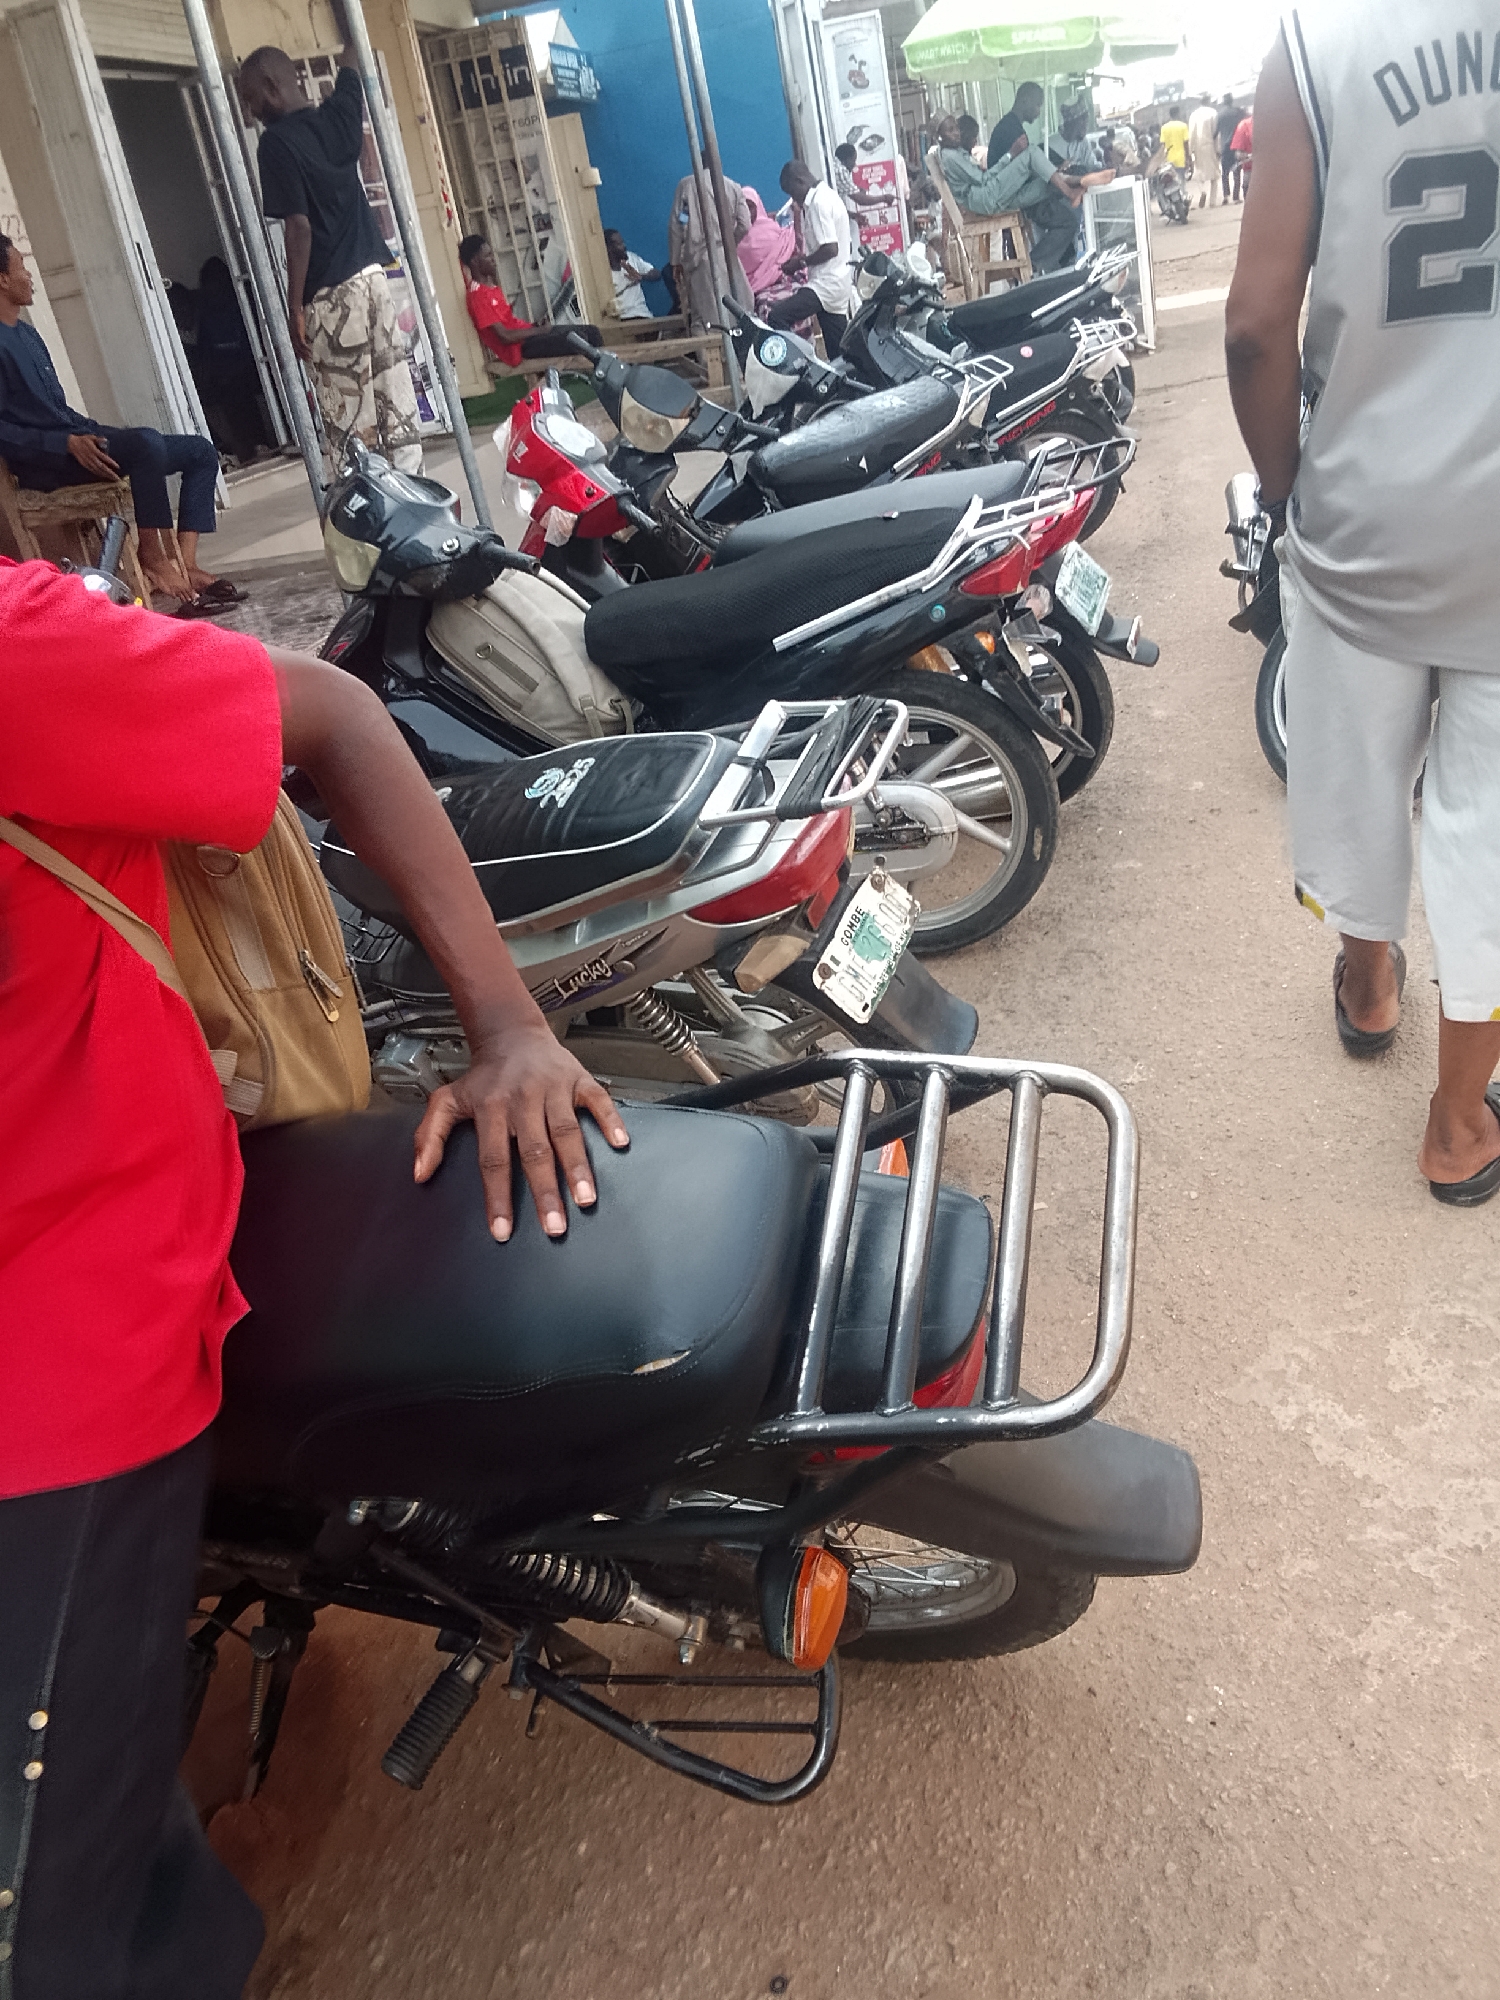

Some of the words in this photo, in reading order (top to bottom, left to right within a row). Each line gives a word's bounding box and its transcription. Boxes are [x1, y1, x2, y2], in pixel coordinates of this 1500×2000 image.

[1380, 144, 1500, 329] 2
[839, 905, 866, 946] GOMBE
[553, 957, 613, 1000] Lucky
